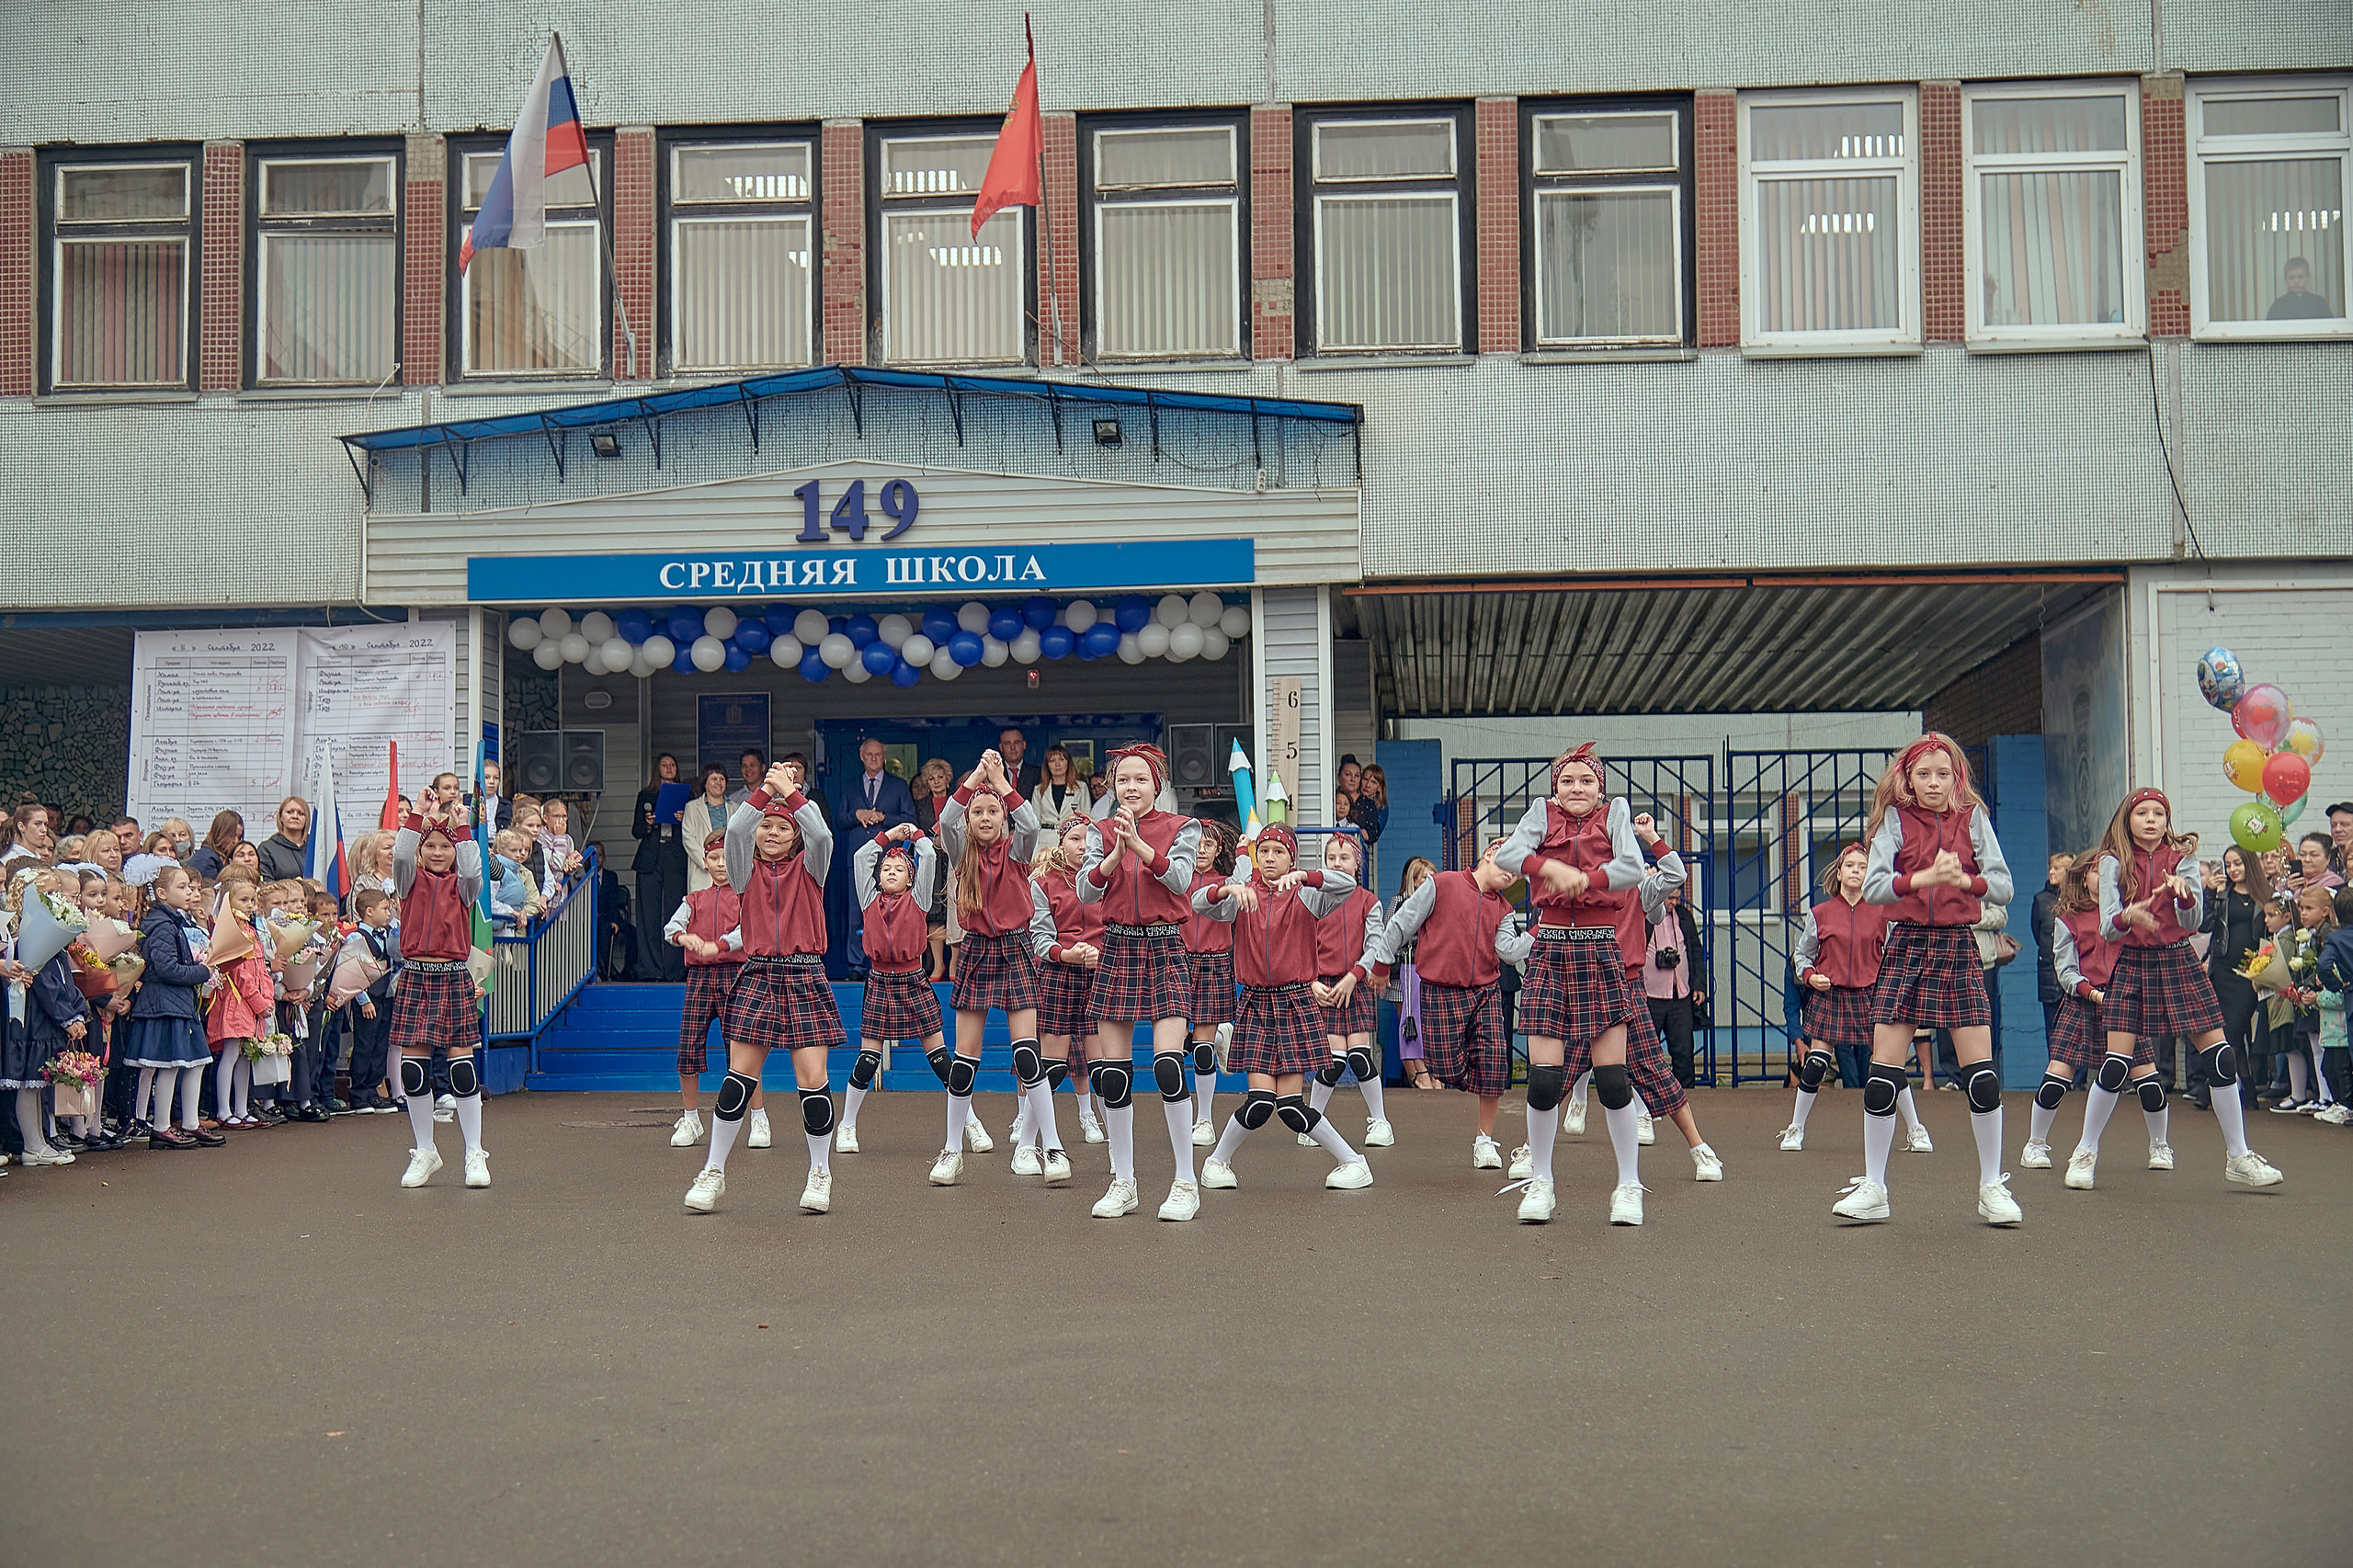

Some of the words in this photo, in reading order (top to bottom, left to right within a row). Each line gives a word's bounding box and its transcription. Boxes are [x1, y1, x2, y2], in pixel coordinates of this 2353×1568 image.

[794, 478, 919, 542] 149
[659, 559, 859, 592] СРЕДНЯЯ
[885, 554, 1048, 584] ШКОЛА
[207, 642, 241, 653] Сентября
[250, 642, 276, 652] 2022
[366, 640, 401, 651] Сентября
[409, 638, 434, 648] 2022
[1288, 690, 1299, 709] 6
[1286, 741, 1298, 759] 5
